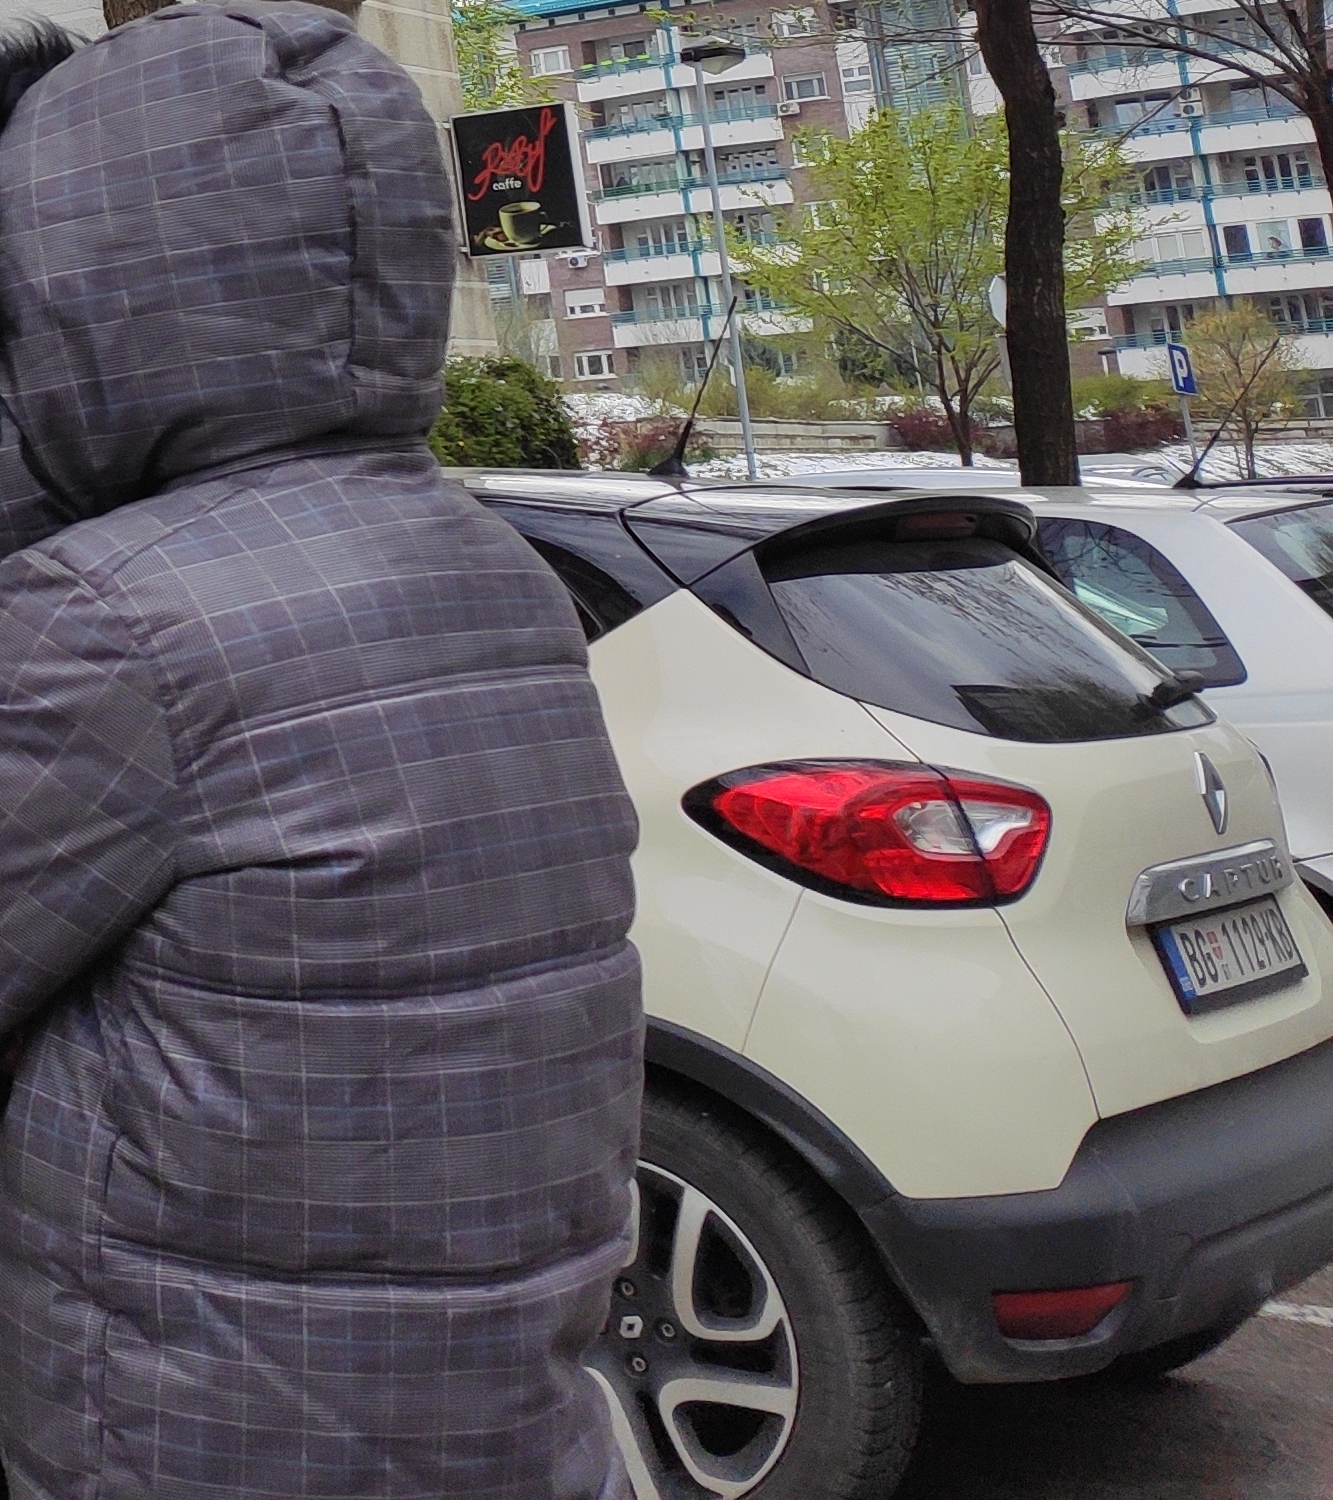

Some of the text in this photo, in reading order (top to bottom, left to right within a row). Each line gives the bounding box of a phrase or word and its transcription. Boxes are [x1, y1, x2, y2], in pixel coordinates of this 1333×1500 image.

[492, 176, 522, 191] caffe
[1172, 349, 1189, 388] P
[1177, 855, 1283, 902] CAPTUR
[1179, 929, 1219, 988] BG
